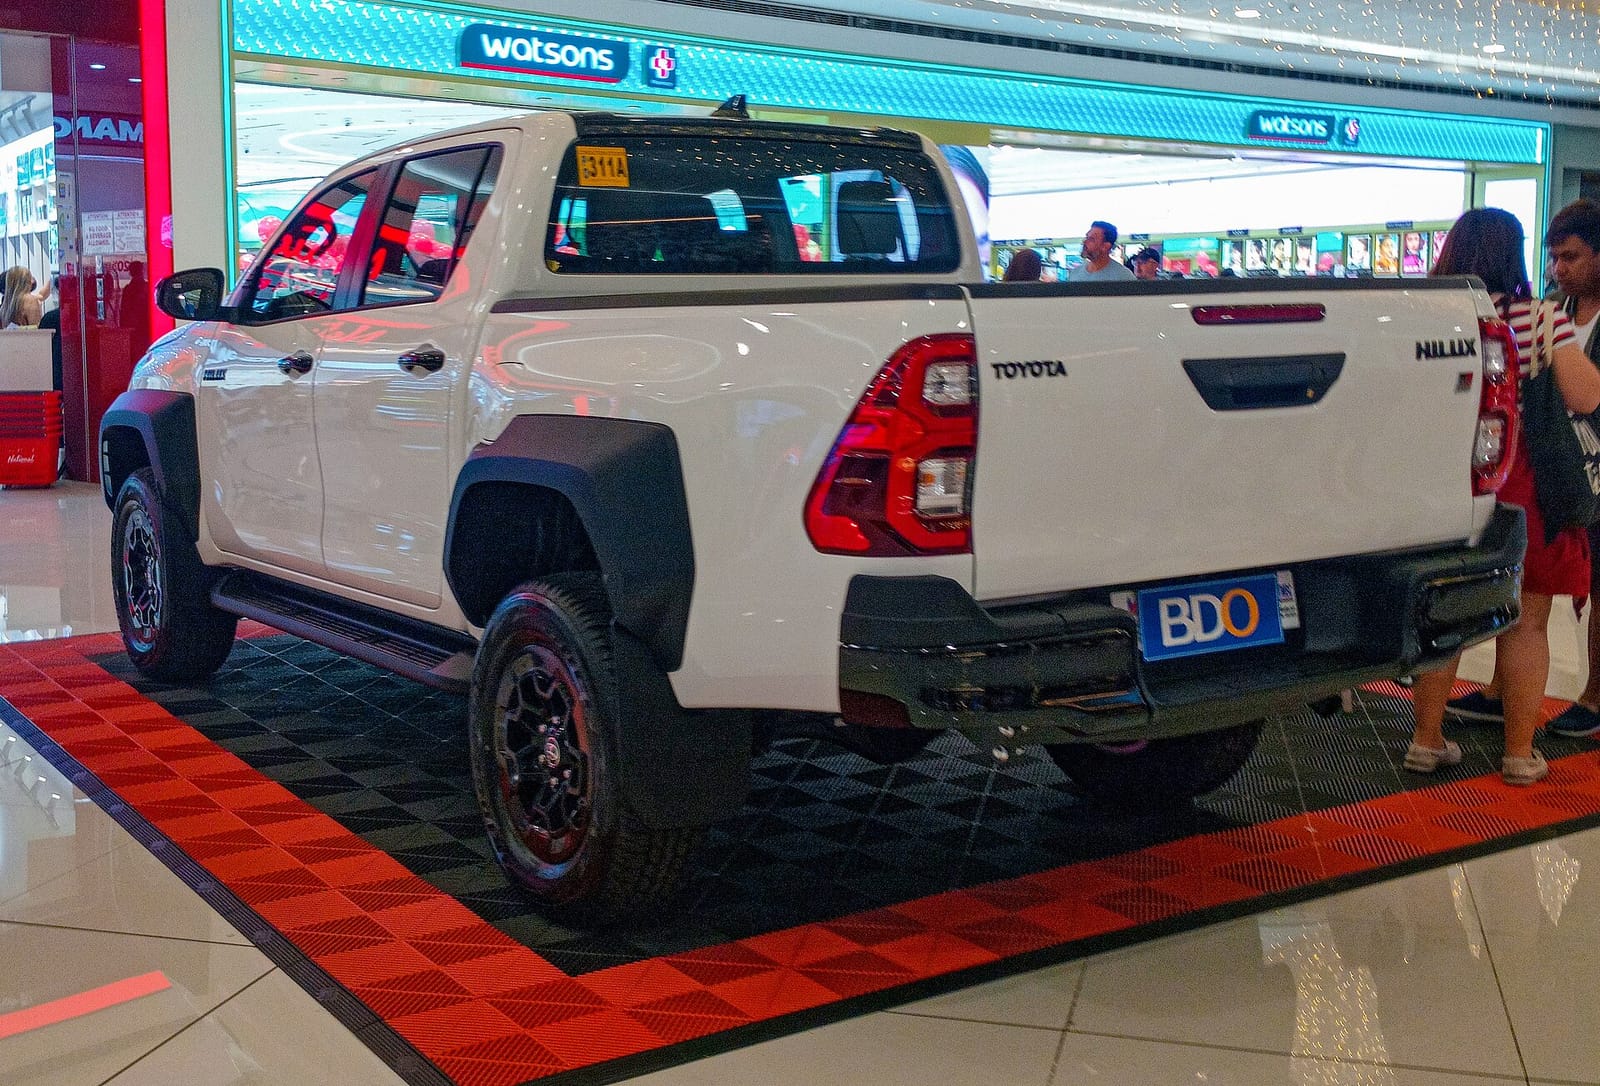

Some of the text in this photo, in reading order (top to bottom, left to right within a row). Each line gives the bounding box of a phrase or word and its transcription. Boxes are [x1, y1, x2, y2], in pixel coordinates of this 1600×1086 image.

[480, 33, 614, 71] watsons
[1259, 115, 1328, 137] watsons
[1415, 338, 1476, 361] HILUX
[990, 360, 1067, 380] TOYOTA
[1158, 588, 1260, 648] BDO
